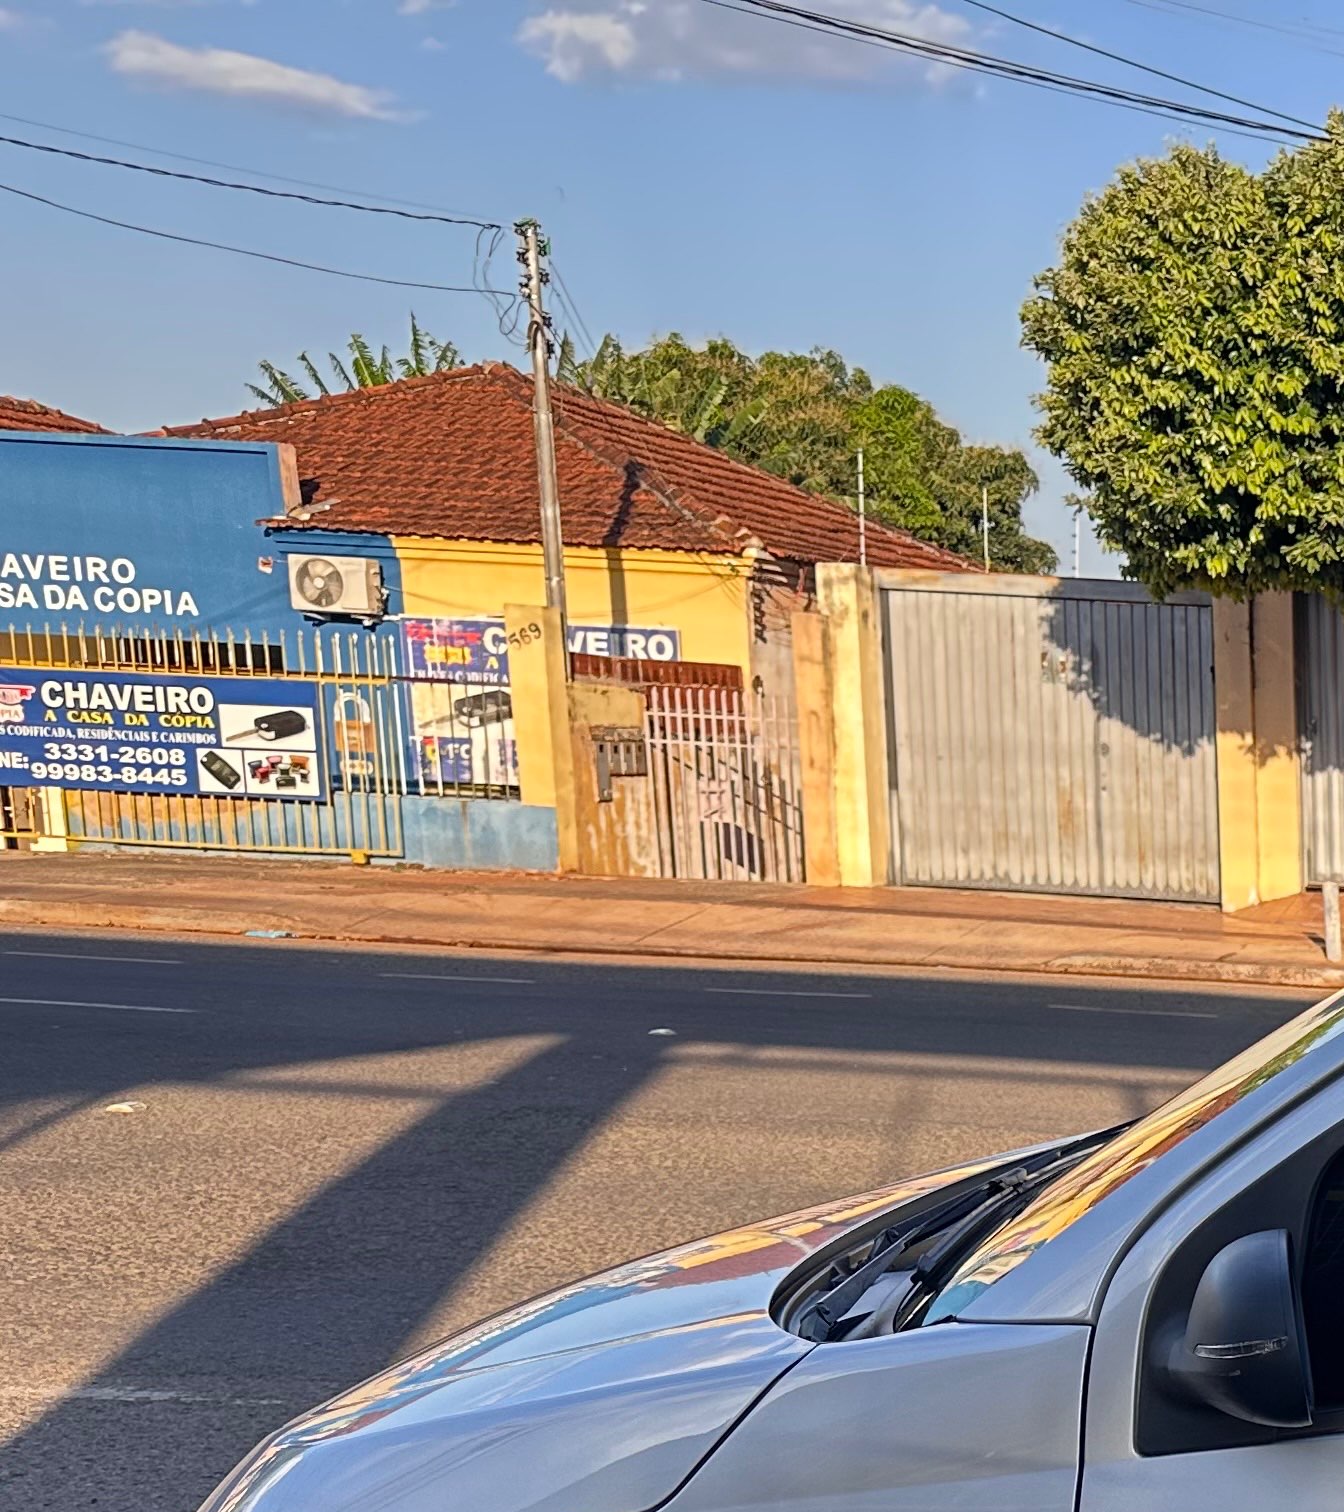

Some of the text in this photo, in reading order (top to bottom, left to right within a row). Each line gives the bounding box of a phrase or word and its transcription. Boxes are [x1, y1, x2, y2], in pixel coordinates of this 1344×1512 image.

[1, 553, 136, 584] AVEIRO
[43, 584, 89, 611] DA
[94, 586, 200, 616] COPIA
[508, 622, 542, 650] 569
[41, 681, 215, 714] CHAVEIRO
[44, 709, 215, 729] A CASA DA CÓPIA
[152, 731, 159, 742] E
[160, 732, 216, 744] CARIMBOS
[44, 742, 187, 766] 3331-2608
[31, 762, 188, 786] 99983-8445
